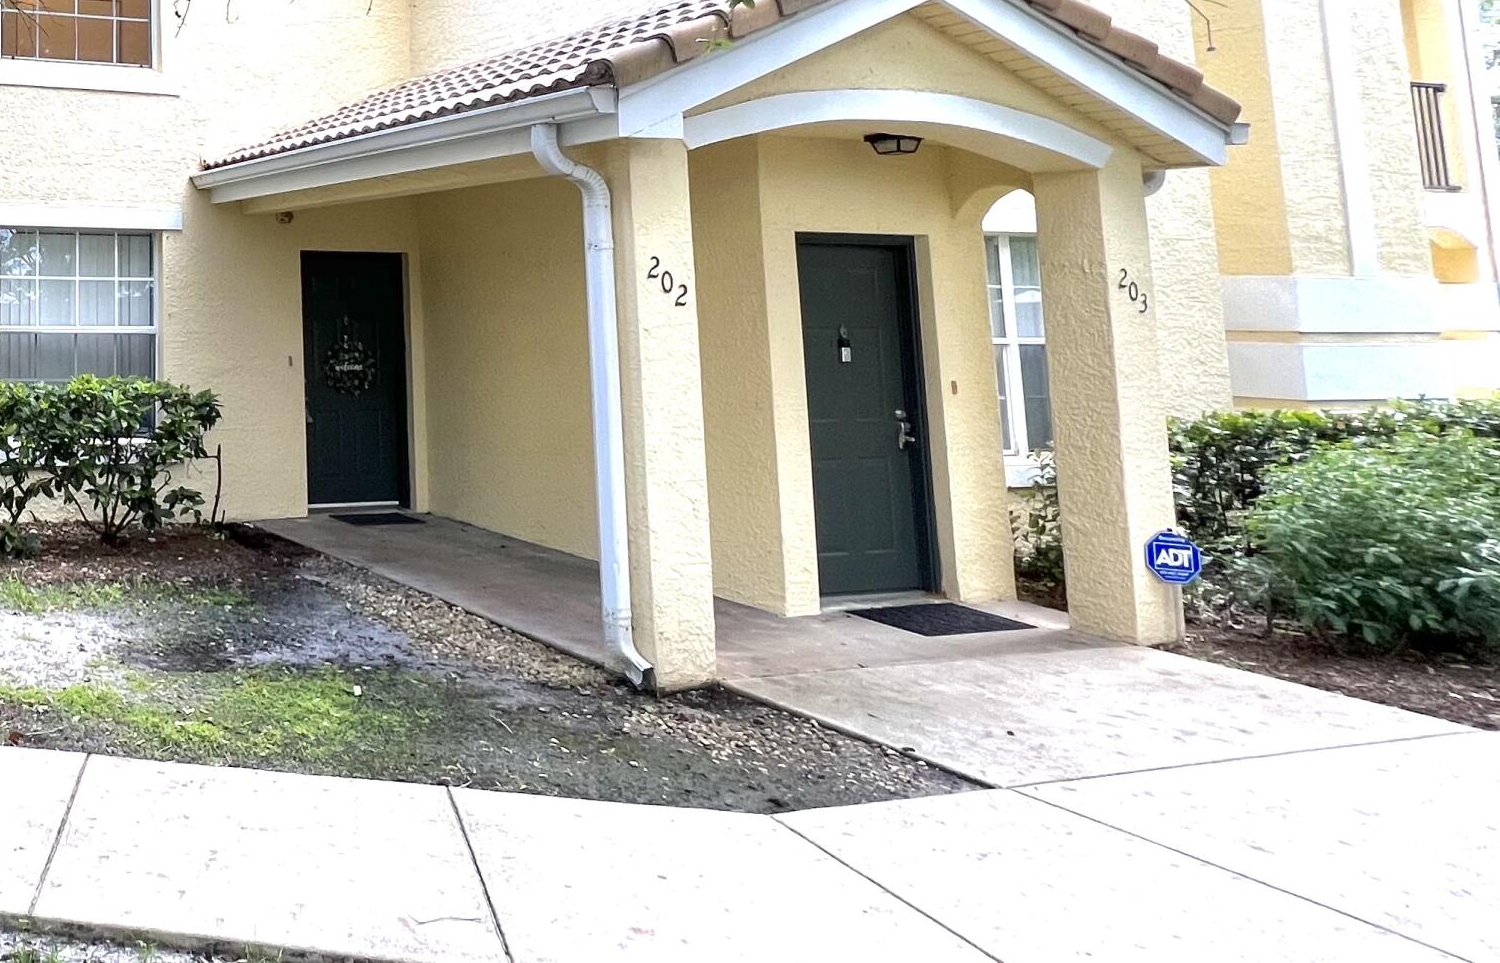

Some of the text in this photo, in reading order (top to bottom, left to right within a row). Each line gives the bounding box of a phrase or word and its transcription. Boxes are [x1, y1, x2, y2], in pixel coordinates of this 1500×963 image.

[647, 256, 688, 307] 202
[1119, 268, 1148, 313] 203
[1156, 548, 1192, 567] ADT
